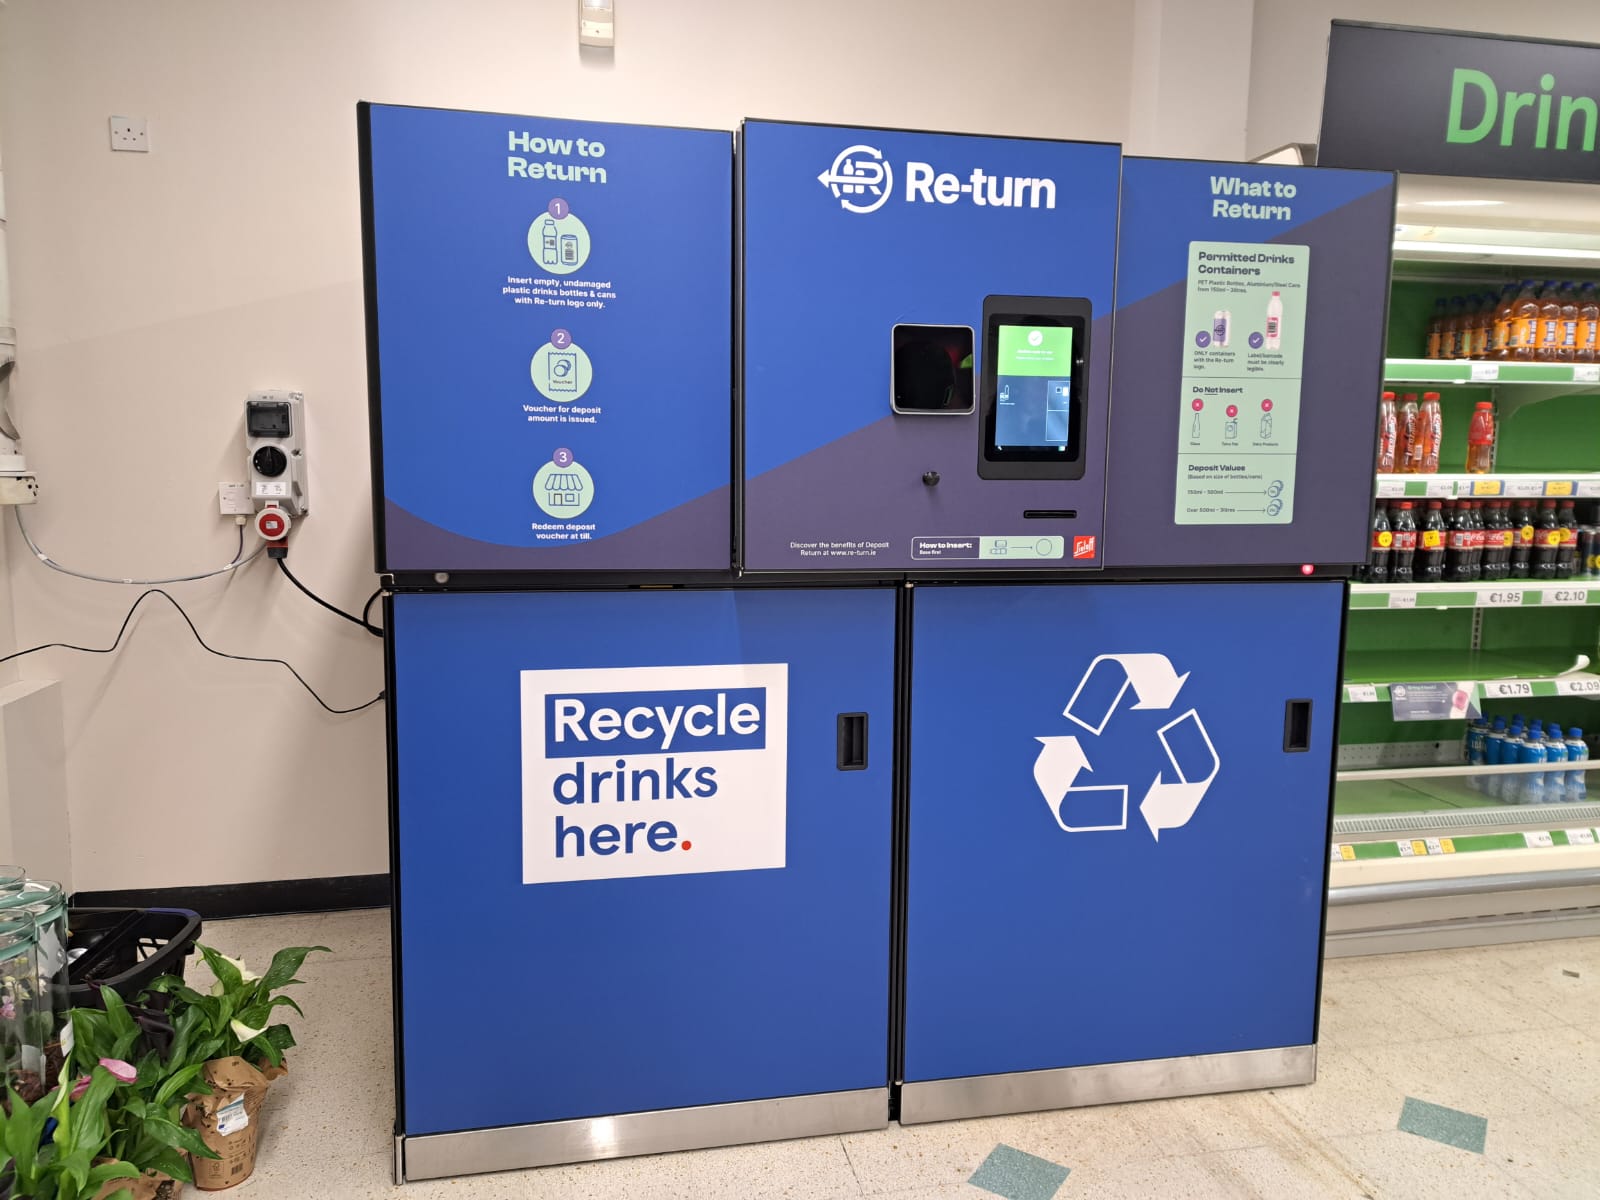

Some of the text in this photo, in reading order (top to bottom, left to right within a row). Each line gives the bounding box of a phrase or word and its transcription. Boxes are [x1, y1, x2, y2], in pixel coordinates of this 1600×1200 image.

[1446, 68, 1598, 152] Drin
[508, 130, 606, 158] How to
[507, 156, 607, 184] Return
[905, 161, 1057, 209] Re-turn
[1210, 175, 1297, 199] What to
[554, 202, 561, 215] 1
[1212, 198, 1292, 221] Return
[1198, 251, 1295, 264] Permitted Drinks
[1197, 264, 1261, 276] Containers
[507, 276, 611, 290] Insert empty, undamaged
[502, 286, 531, 295] plastic
[532, 287, 558, 296] drinks
[559, 288, 588, 298] bottles
[589, 290, 596, 298] &
[514, 296, 606, 310] with Re-turn logo only.
[557, 332, 565, 344] 2
[1219, 386, 1243, 394] Insert
[522, 404, 602, 415] Voucher for deposit
[527, 415, 598, 424] amount is issued.
[559, 451, 567, 463] 3
[1188, 464, 1219, 472] Deposit
[531, 522, 596, 532] Redeem deposit
[536, 532, 569, 540] voucher
[579, 532, 593, 540] till.
[790, 541, 818, 549] Discover
[865, 541, 890, 549] Deposit
[1489, 592, 1521, 603] €1.95
[1555, 591, 1585, 602] €2.10
[1498, 683, 1530, 695] €1.79
[1569, 681, 1600, 692] €2.09
[554, 693, 761, 750] Recycle
[553, 757, 718, 805] drinks
[555, 815, 692, 858] here.
